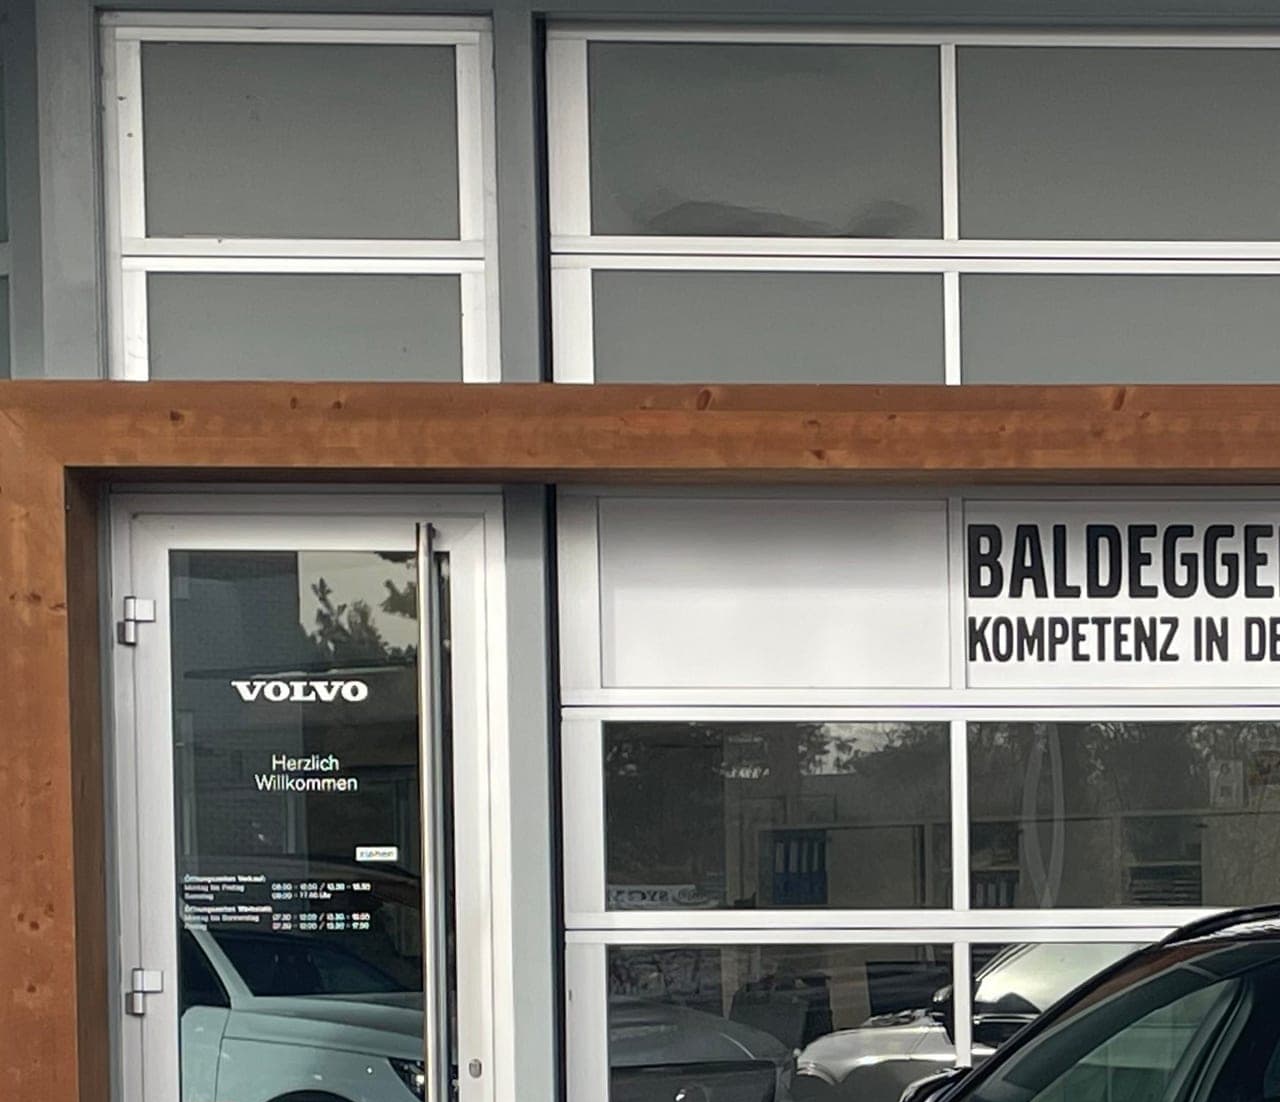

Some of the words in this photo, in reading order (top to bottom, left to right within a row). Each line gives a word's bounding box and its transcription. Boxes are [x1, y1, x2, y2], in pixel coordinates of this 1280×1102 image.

[967, 616, 1178, 663] KOMPETENZ
[1194, 616, 1229, 662] IN
[231, 680, 369, 702] VOLVO
[271, 754, 340, 771] Herzlich
[255, 774, 358, 792] Willkommen
